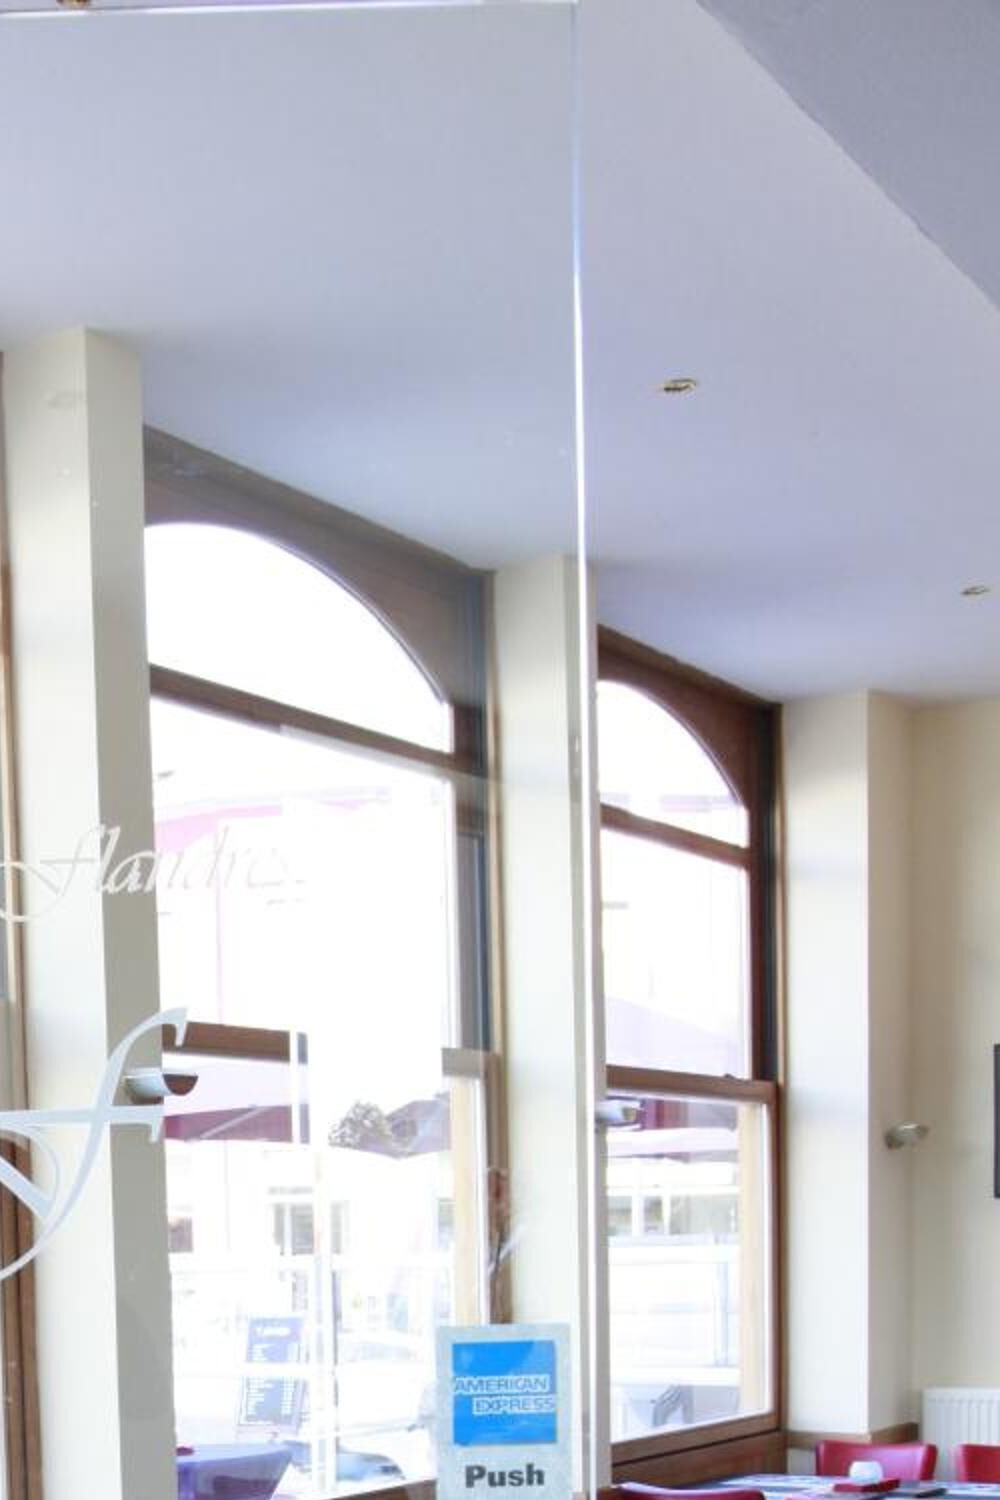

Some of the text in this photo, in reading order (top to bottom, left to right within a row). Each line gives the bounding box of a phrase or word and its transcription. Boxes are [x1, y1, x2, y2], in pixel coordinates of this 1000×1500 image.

[455, 1375, 548, 1393] AMERICAN
[475, 1396, 554, 1412] EXPRESS
[464, 1463, 545, 1488] Push
